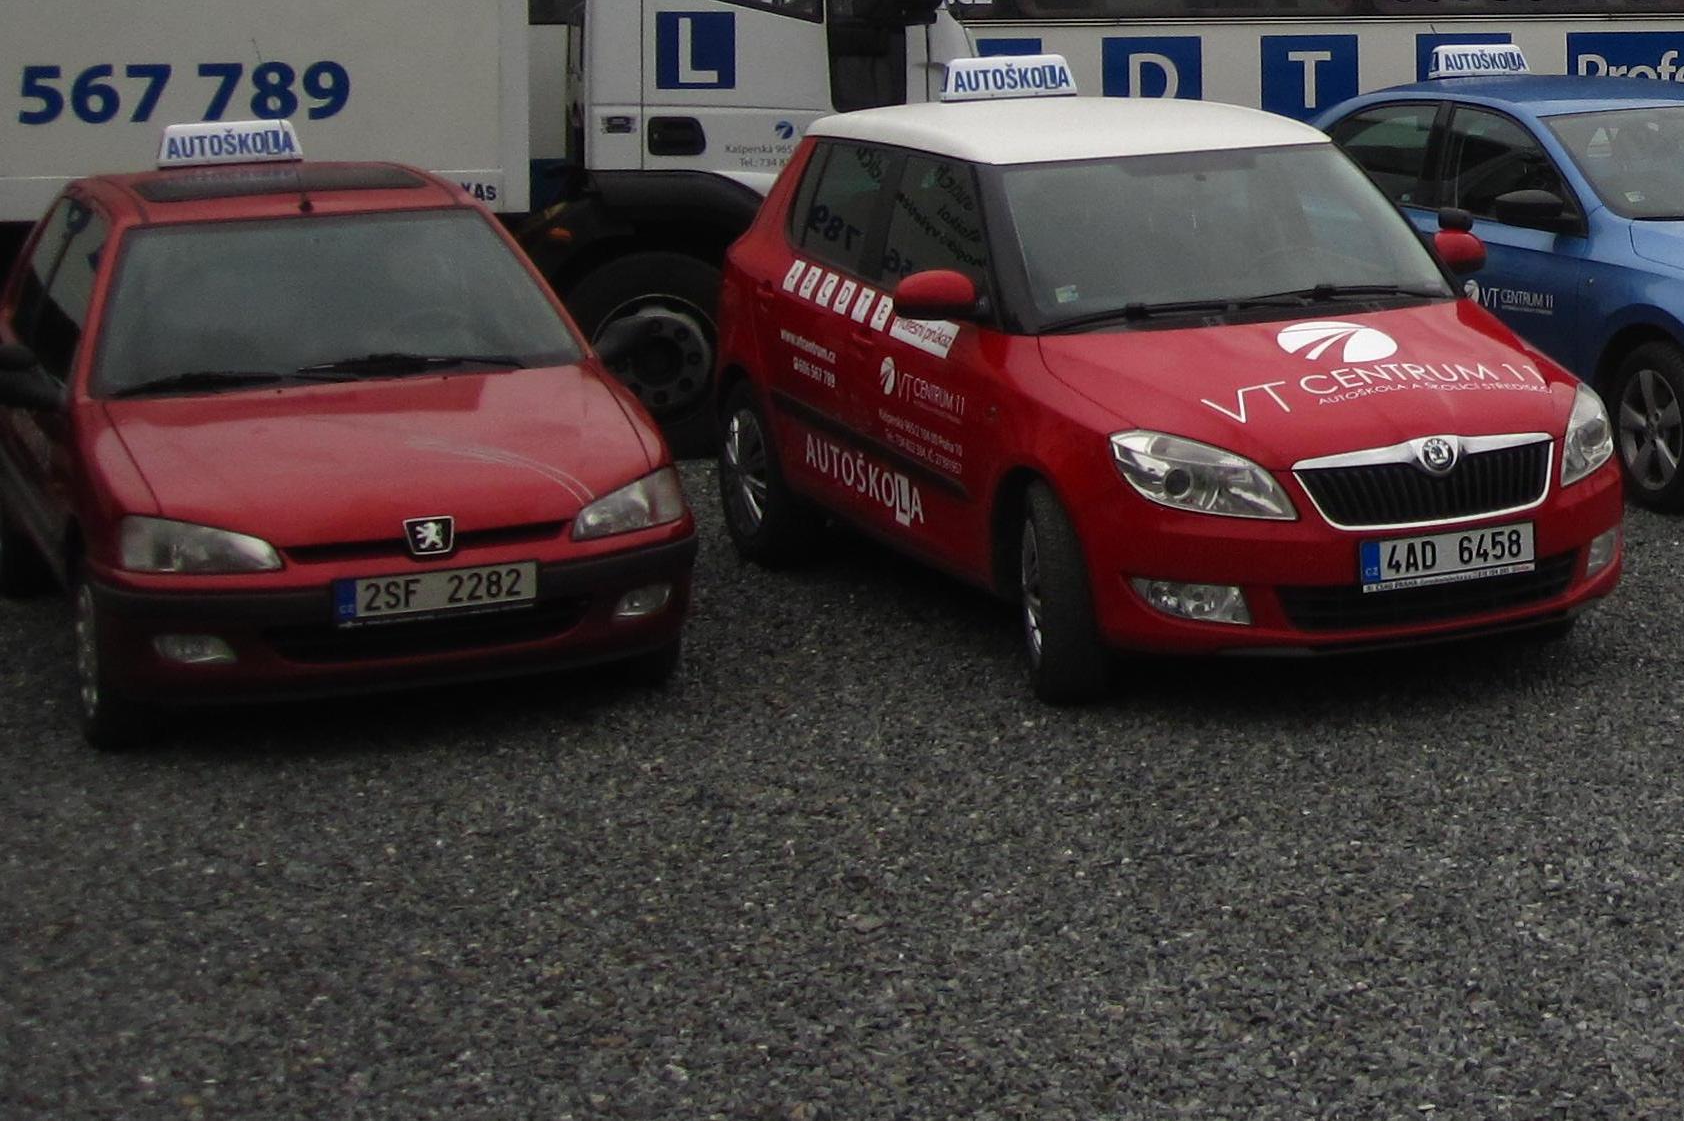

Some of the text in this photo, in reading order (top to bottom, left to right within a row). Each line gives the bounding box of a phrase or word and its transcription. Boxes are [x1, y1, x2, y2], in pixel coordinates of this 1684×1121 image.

[678, 17, 719, 83] L
[1444, 49, 1527, 72] AUTOŠKOLA
[18, 60, 351, 125] 567 789
[954, 63, 1070, 93] AUTOŠKOLA
[1288, 51, 1332, 109] T
[166, 128, 295, 160] AUTOŠKOLA
[1481, 287, 1500, 308] VT
[1500, 289, 1543, 308] CENTRUM
[1200, 380, 1292, 424] VT
[1299, 363, 1498, 395] CENTRUM
[806, 433, 924, 526] AUTOŠKOLA
[1387, 540, 1437, 575] 4AD
[1458, 529, 1522, 565] 6458
[364, 568, 522, 612] 2SF 2282
